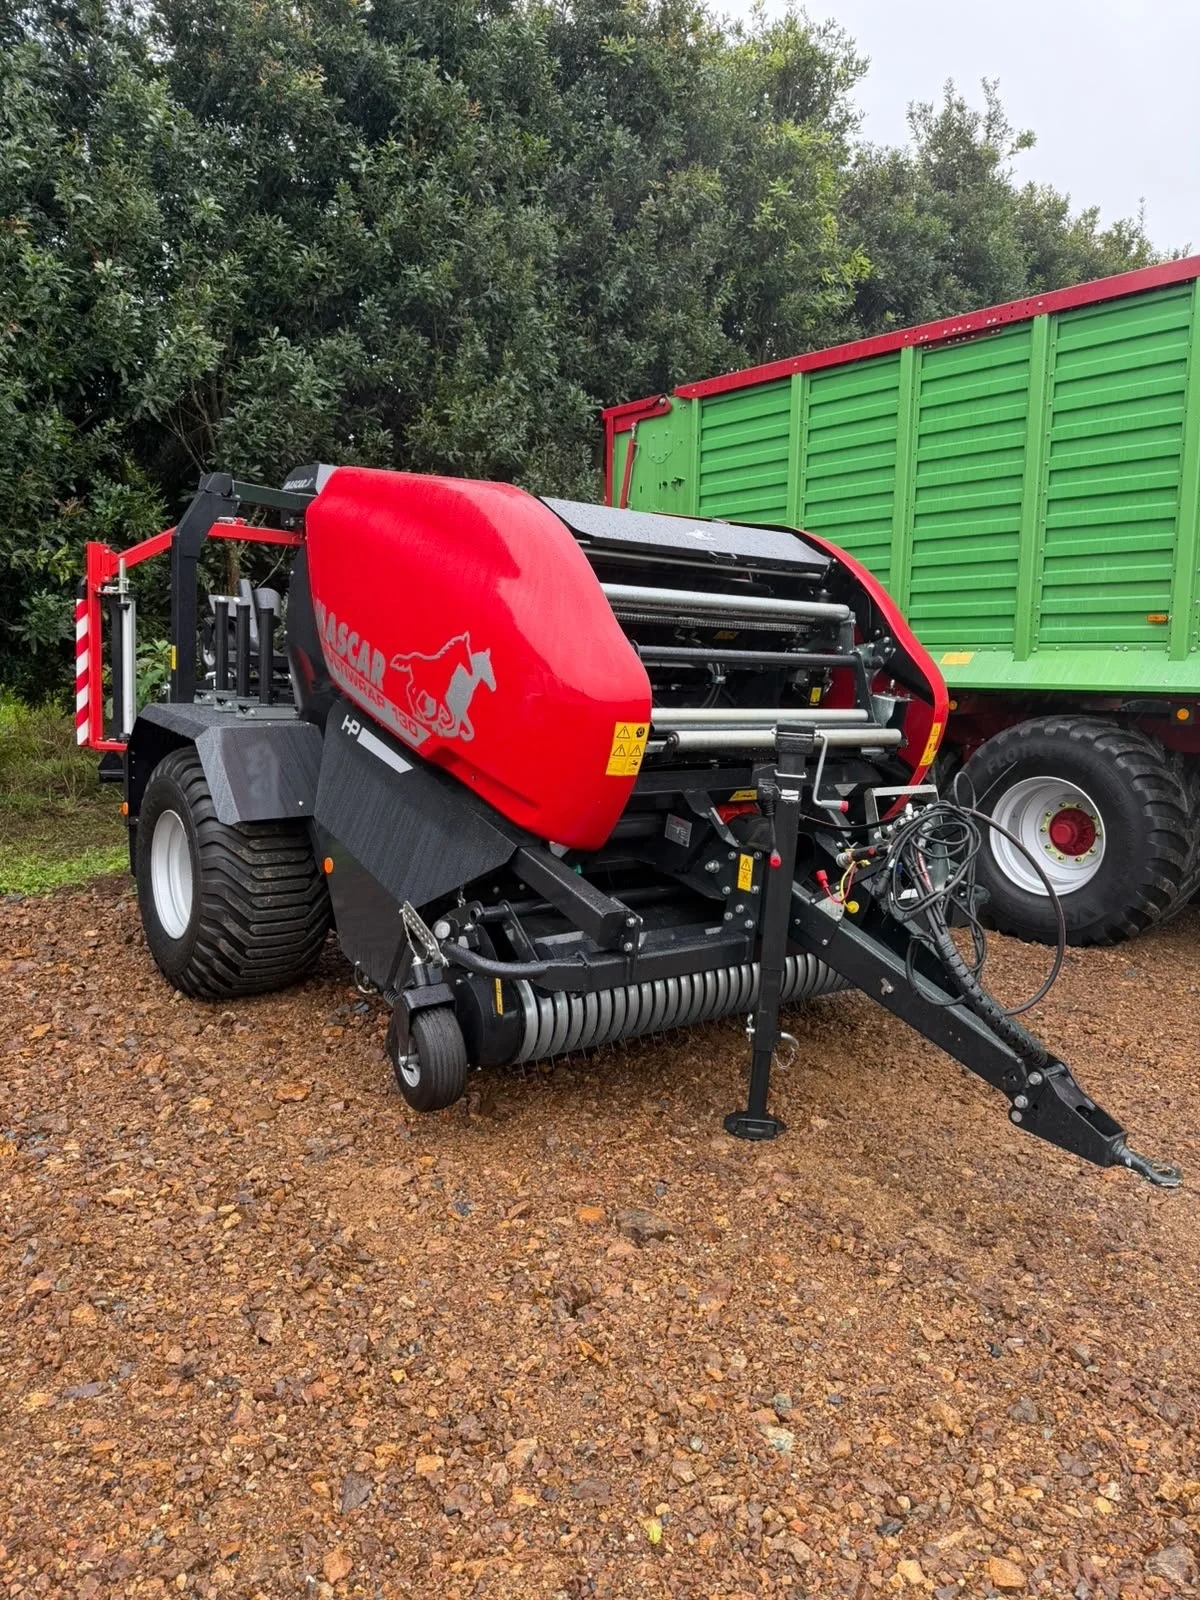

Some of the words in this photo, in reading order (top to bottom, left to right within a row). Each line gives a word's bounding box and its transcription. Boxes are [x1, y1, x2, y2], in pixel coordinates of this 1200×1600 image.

[314, 598, 387, 693] MASCAR
[341, 713, 361, 736] HP
[391, 706, 420, 739] 130
